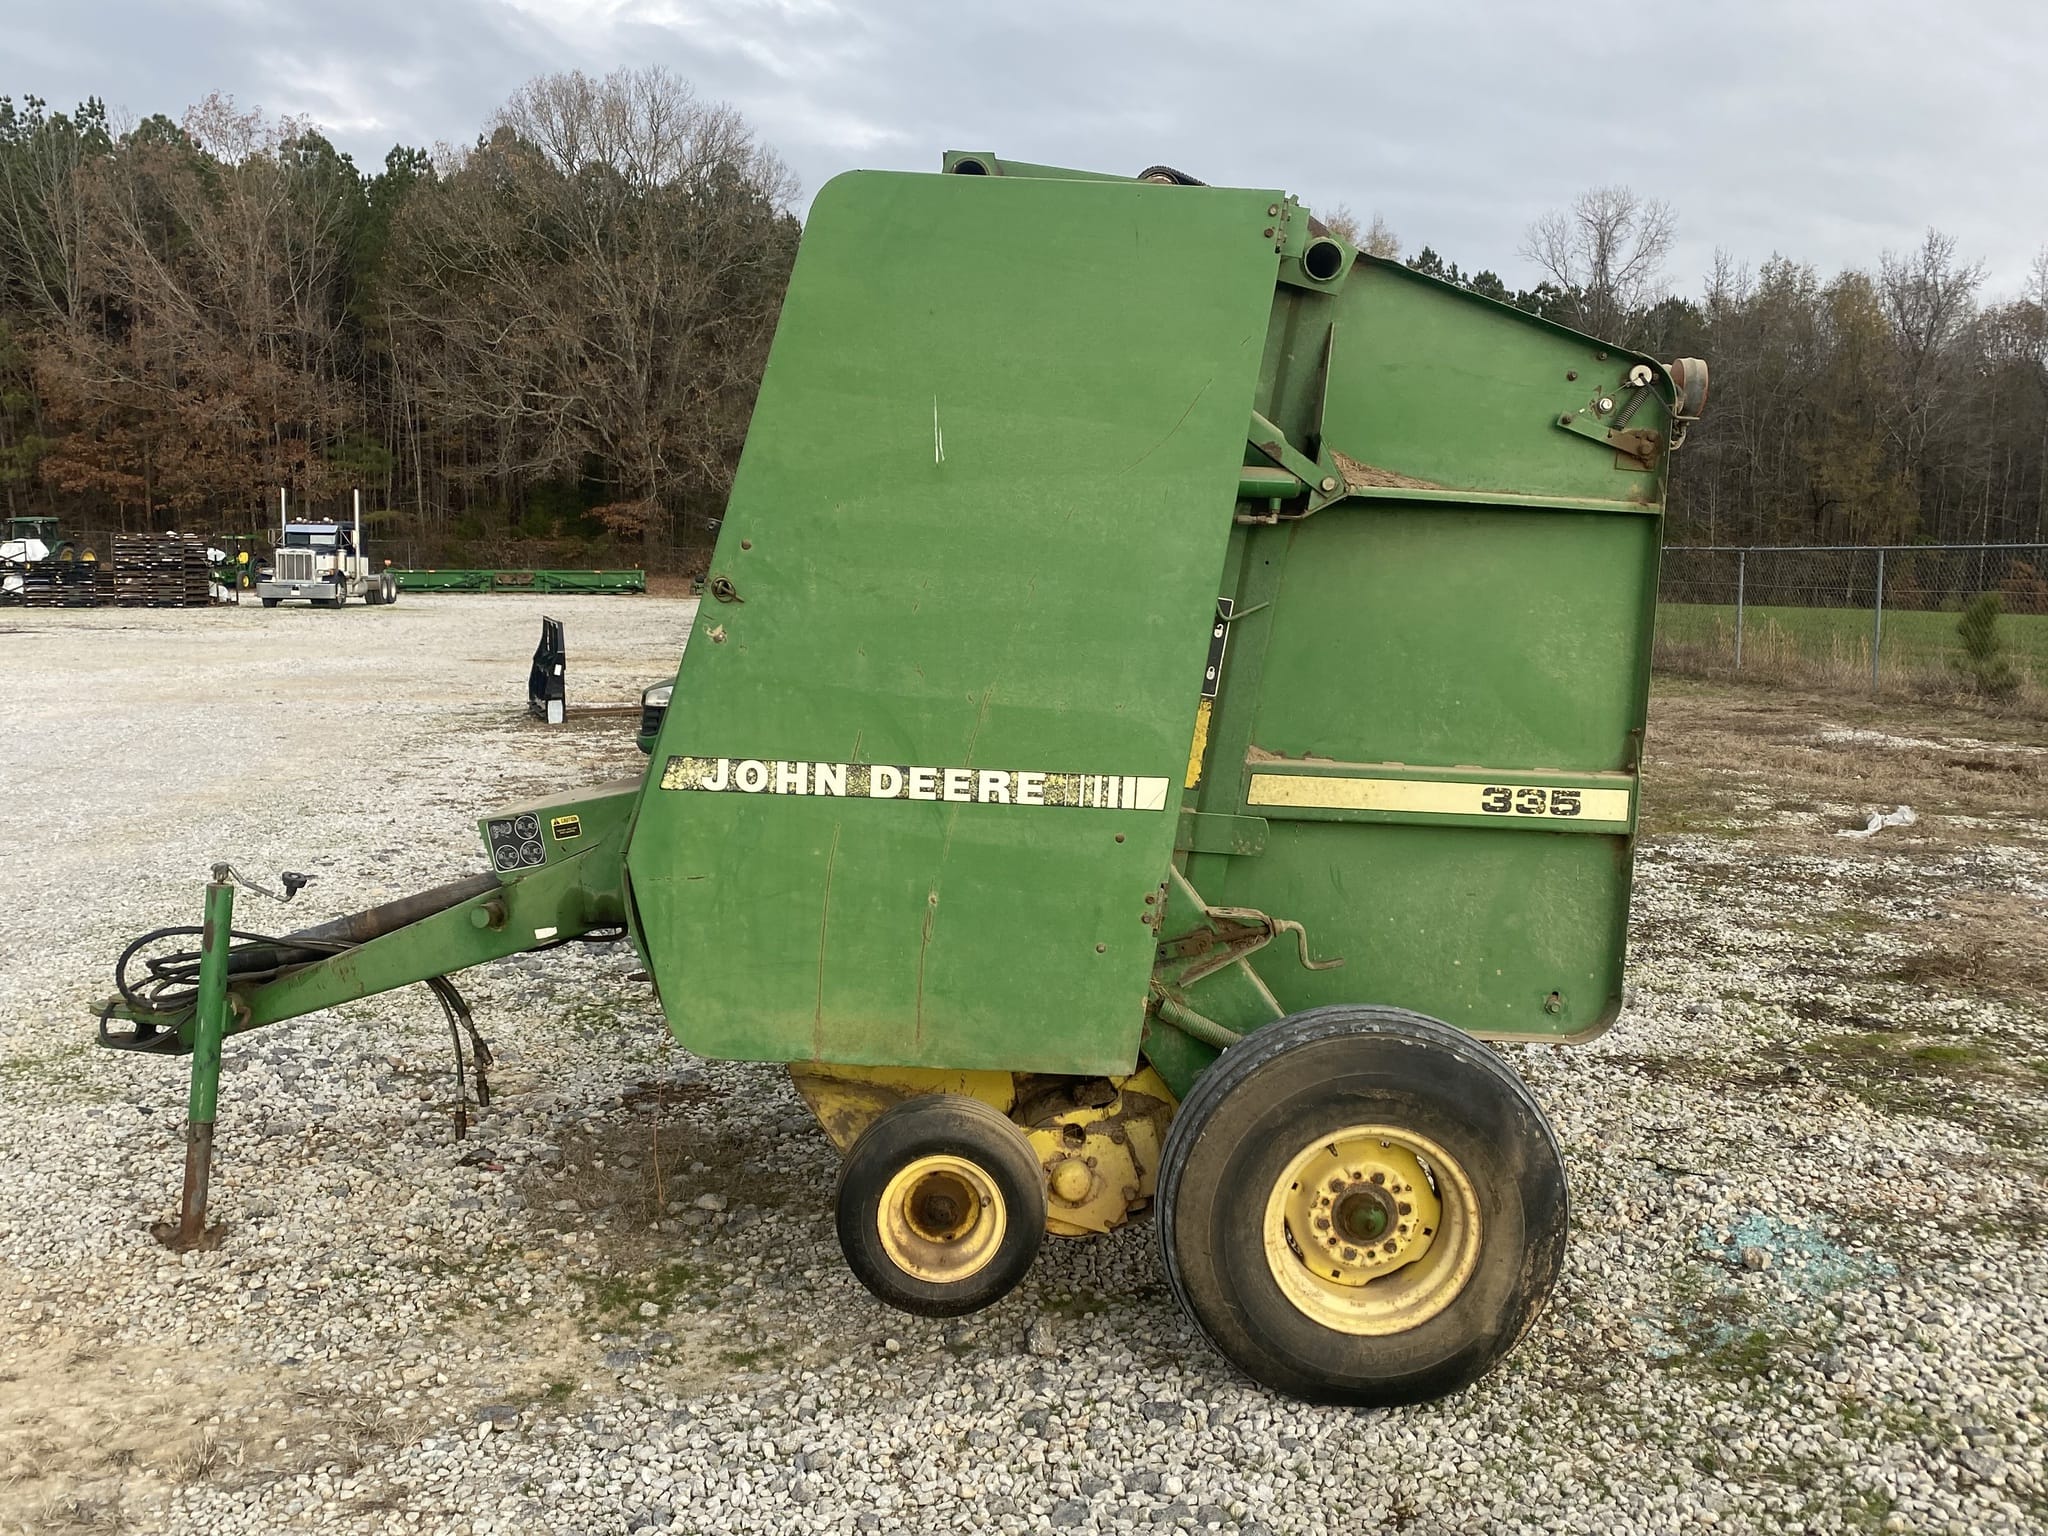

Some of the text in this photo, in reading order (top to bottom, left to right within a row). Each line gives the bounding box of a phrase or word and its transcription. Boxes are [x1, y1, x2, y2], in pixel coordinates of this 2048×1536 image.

[701, 758, 1046, 806] JOHN DEERE
[1481, 787, 1581, 816] 335
